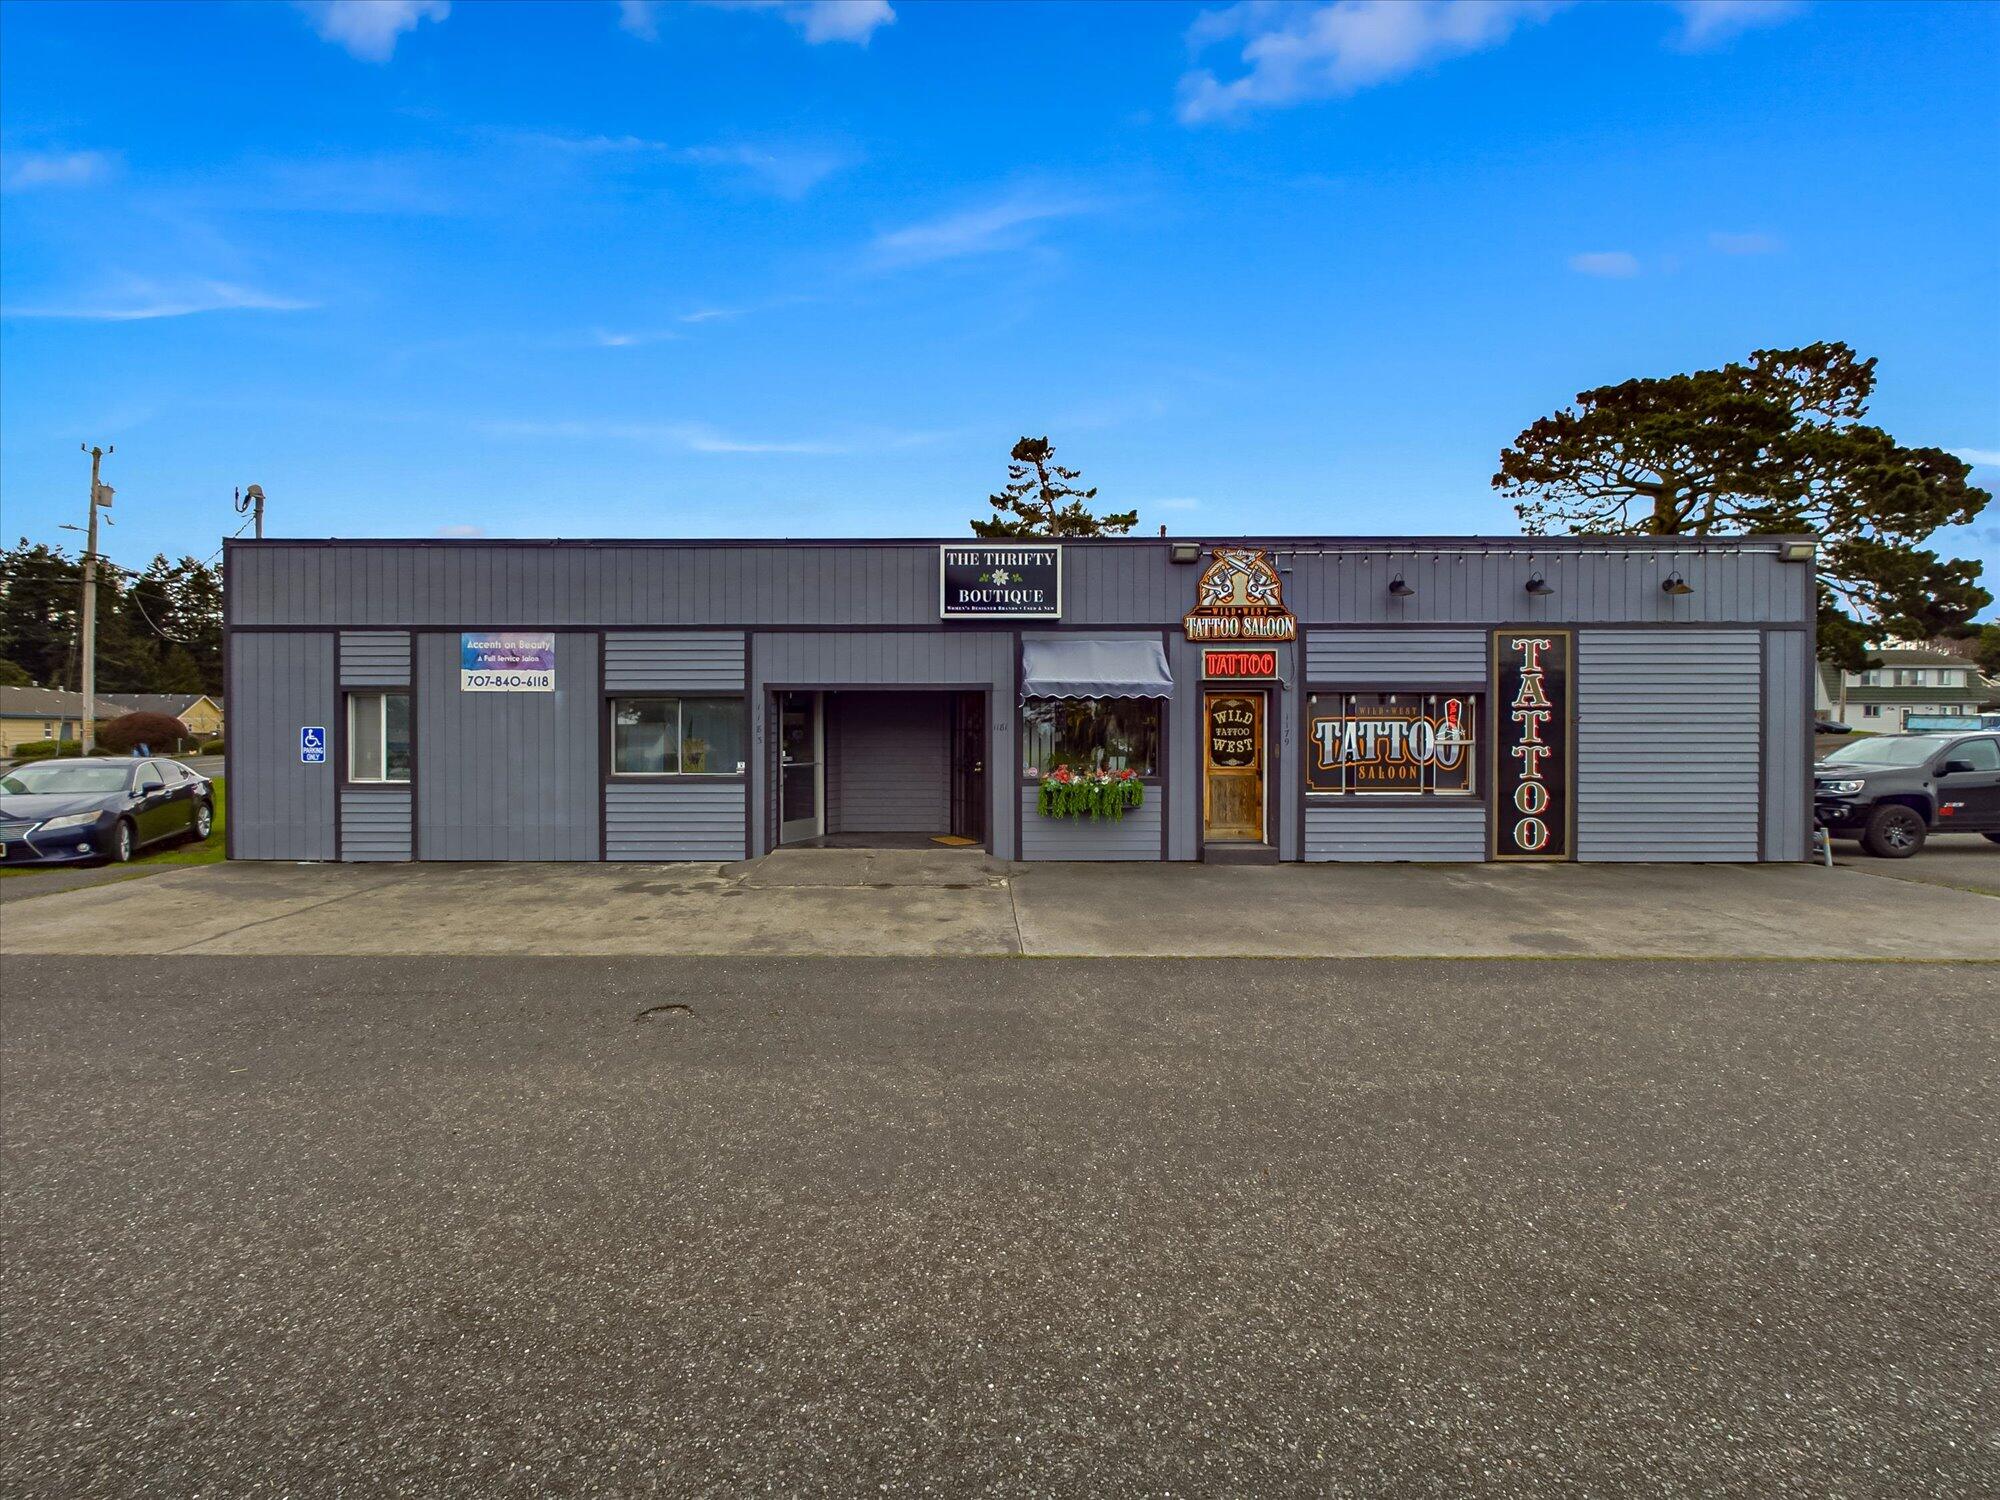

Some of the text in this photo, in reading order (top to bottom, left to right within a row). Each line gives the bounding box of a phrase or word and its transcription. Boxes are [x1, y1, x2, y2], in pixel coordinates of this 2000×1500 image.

[946, 552, 1055, 566] THE THRIFTY
[959, 589, 1044, 604] BOUTIQUE
[1212, 607, 1269, 615] WILD WEST
[1186, 617, 1295, 637] TATTOO SALOON
[467, 640, 501, 649] Accents
[519, 640, 550, 650] Beauty
[1206, 653, 1274, 675] TATTOO
[467, 675, 549, 687] 707-840-6118
[1213, 709, 1253, 725] WILD
[1358, 706, 1417, 715] WILD WEST
[1215, 727, 1250, 736] TATTOO
[1213, 738, 1253, 753] WEST
[1315, 721, 1460, 766] TATTOO
[1511, 638, 1551, 851] TATTOO
[1358, 766, 1417, 780] SALOON
